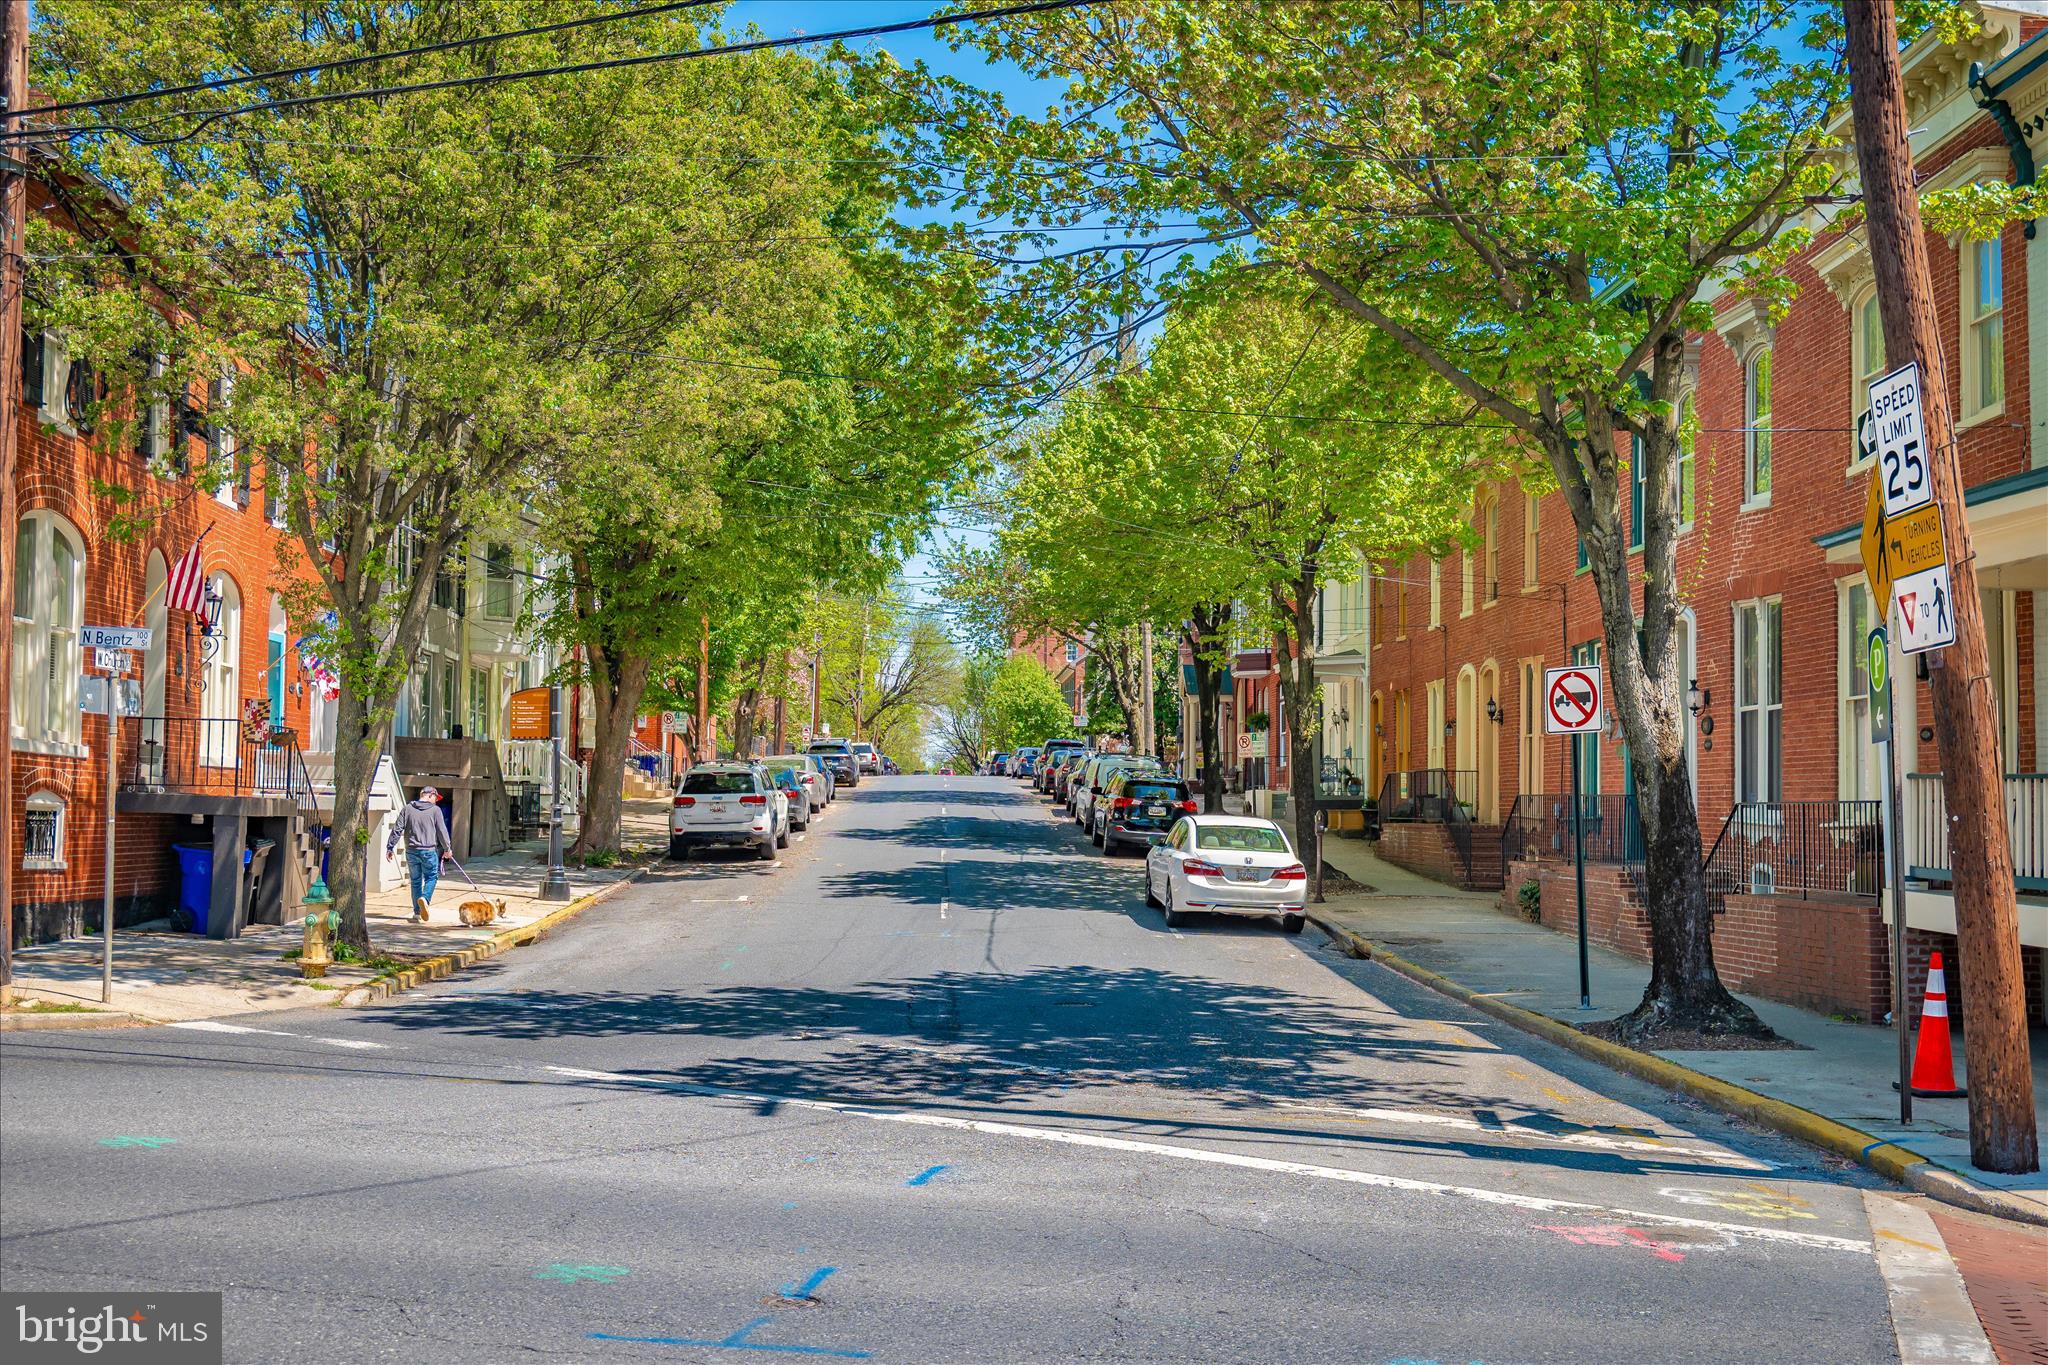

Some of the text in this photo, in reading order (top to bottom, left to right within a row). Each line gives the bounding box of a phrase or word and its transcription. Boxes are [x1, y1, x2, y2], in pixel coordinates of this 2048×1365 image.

[1875, 383, 1915, 419] SPEED
[1882, 413, 1913, 444] LIMIT
[1883, 440, 1923, 500] 25
[1903, 515, 1937, 541] TURNING
[1906, 540, 1941, 565] VEHICLES
[1919, 602, 1930, 618] TO
[83, 630, 93, 644] N.
[96, 631, 133, 646] Bentz
[137, 631, 148, 639] 100
[104, 652, 125, 669] Chch
